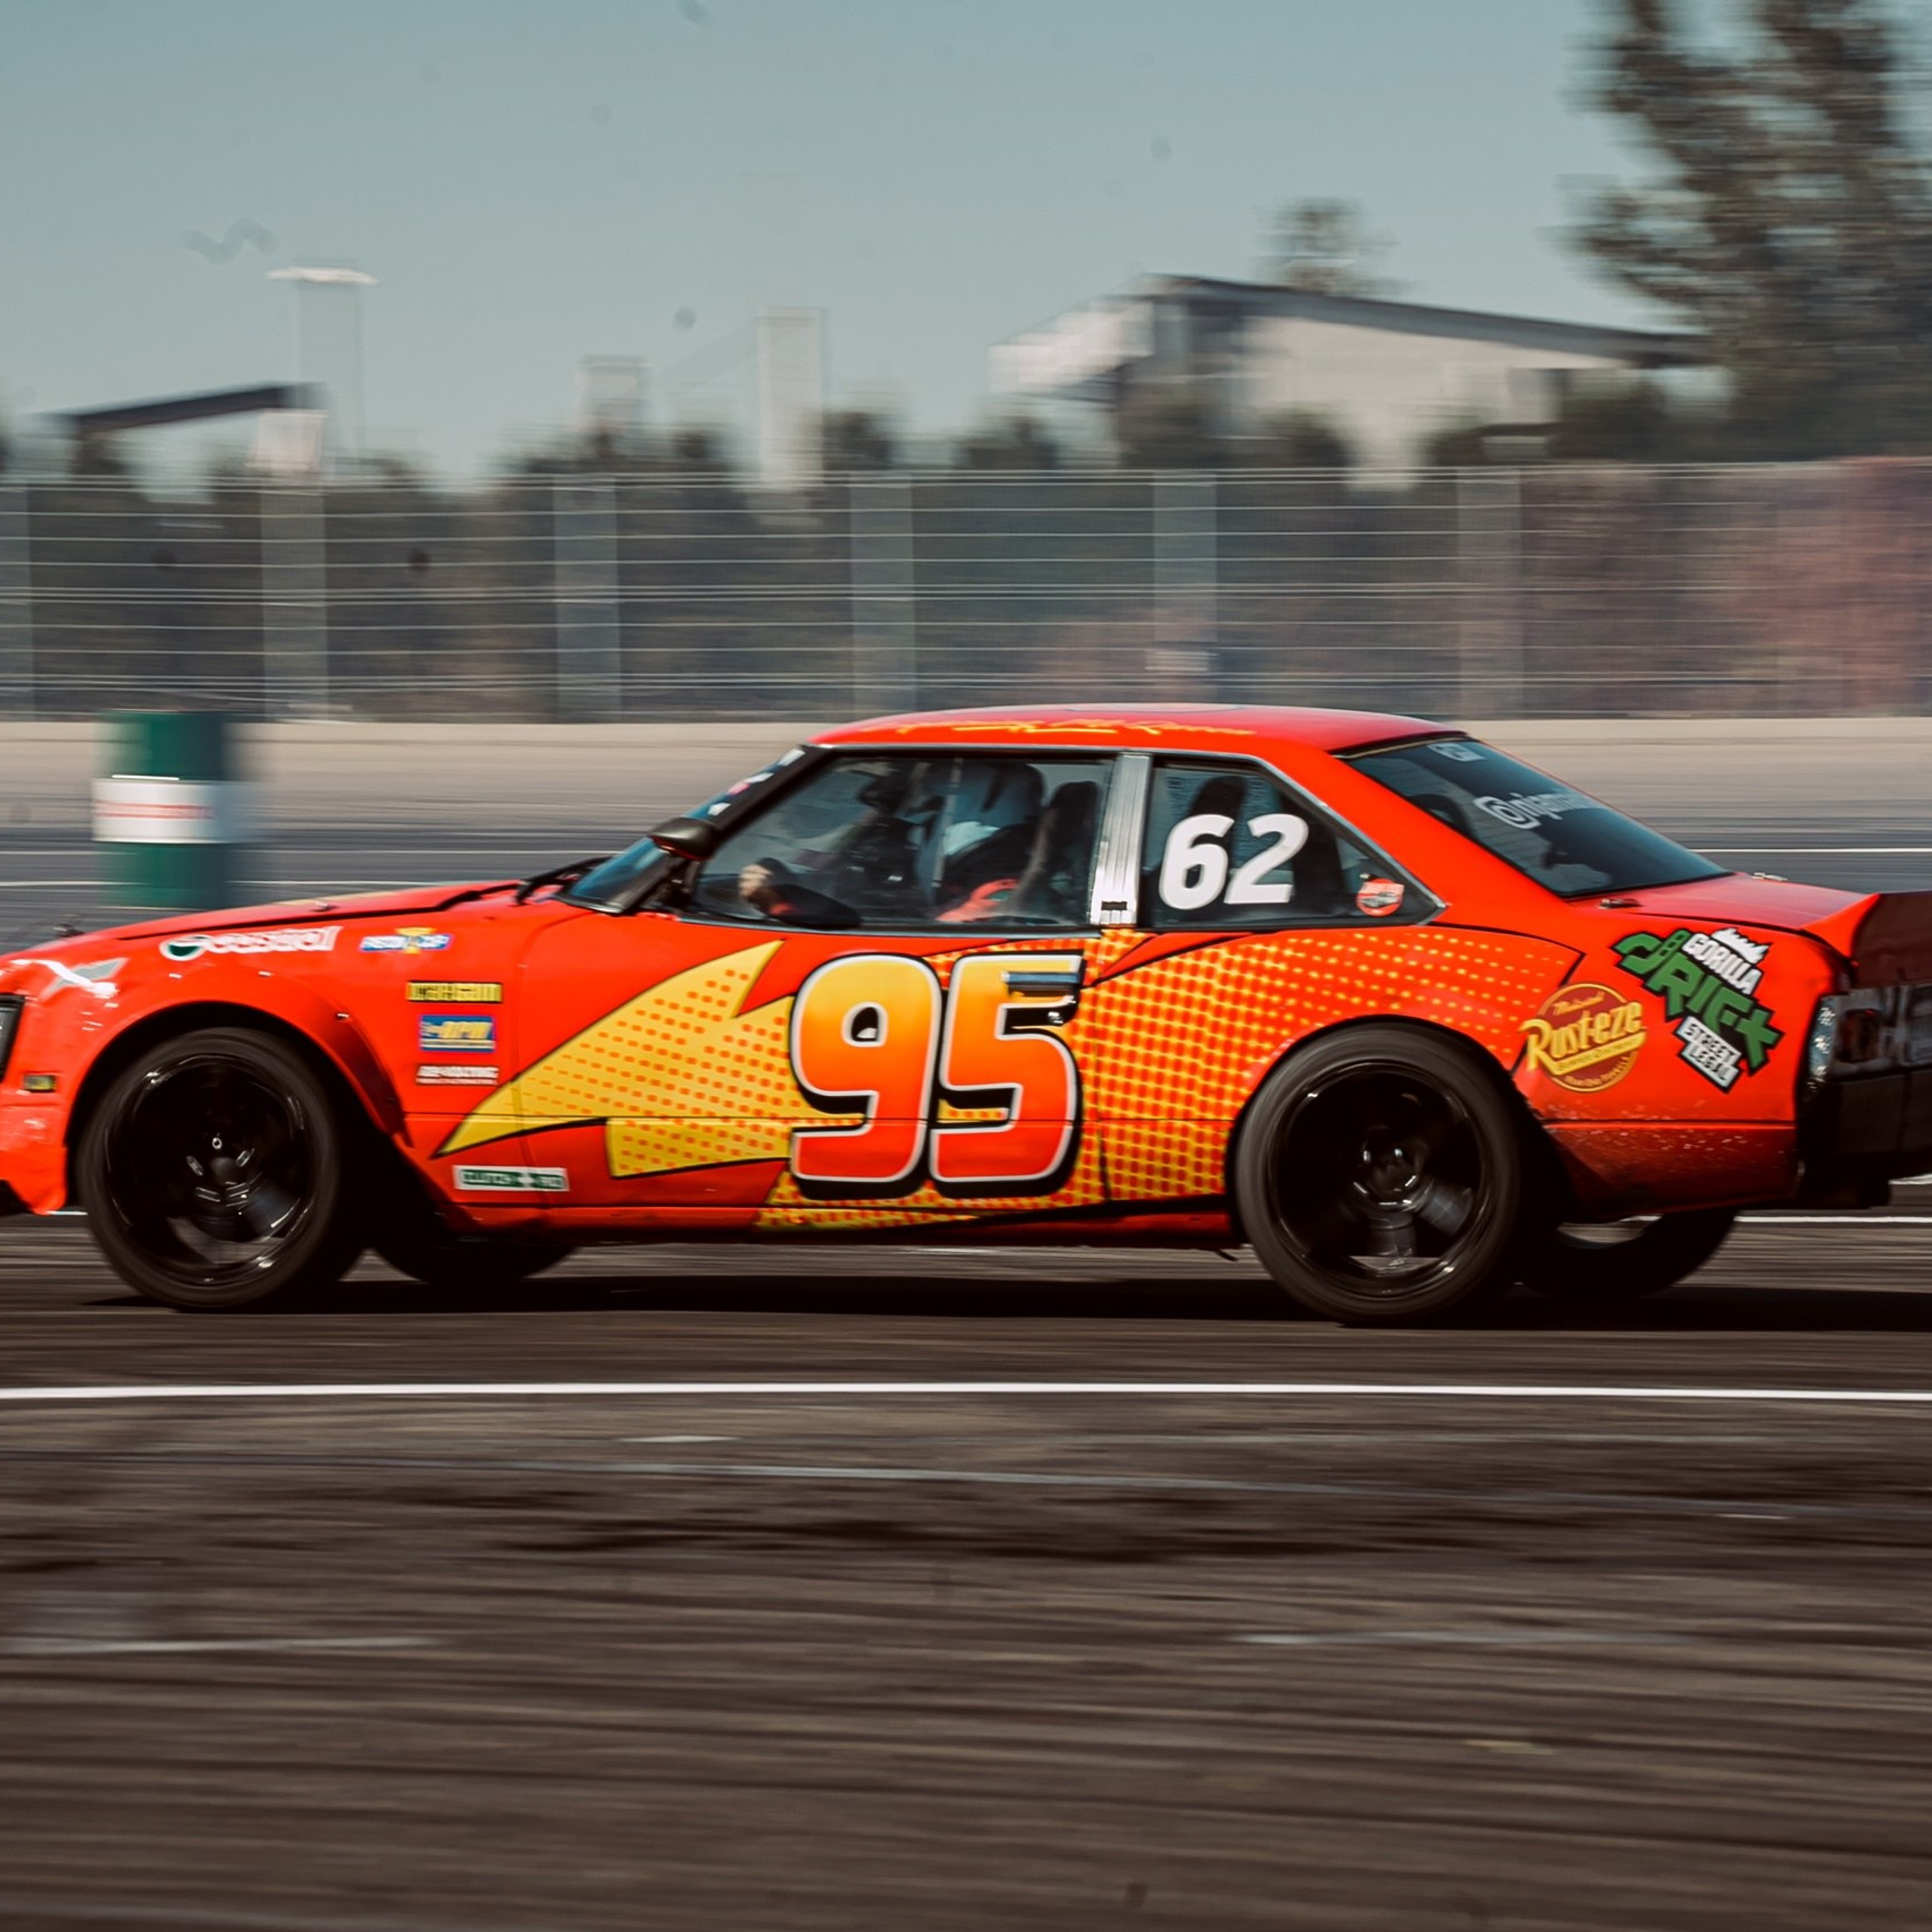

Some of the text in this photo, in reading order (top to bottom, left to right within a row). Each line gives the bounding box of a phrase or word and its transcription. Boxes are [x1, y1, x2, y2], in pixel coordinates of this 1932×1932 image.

[1158, 814, 1309, 910] 62
[1614, 929, 1780, 1069] DRIFT
[1682, 934, 1762, 995] GORILLA
[789, 951, 1085, 1195] 95
[1683, 1021, 1737, 1067] STREET
[1687, 1043, 1732, 1083] LEGAL
